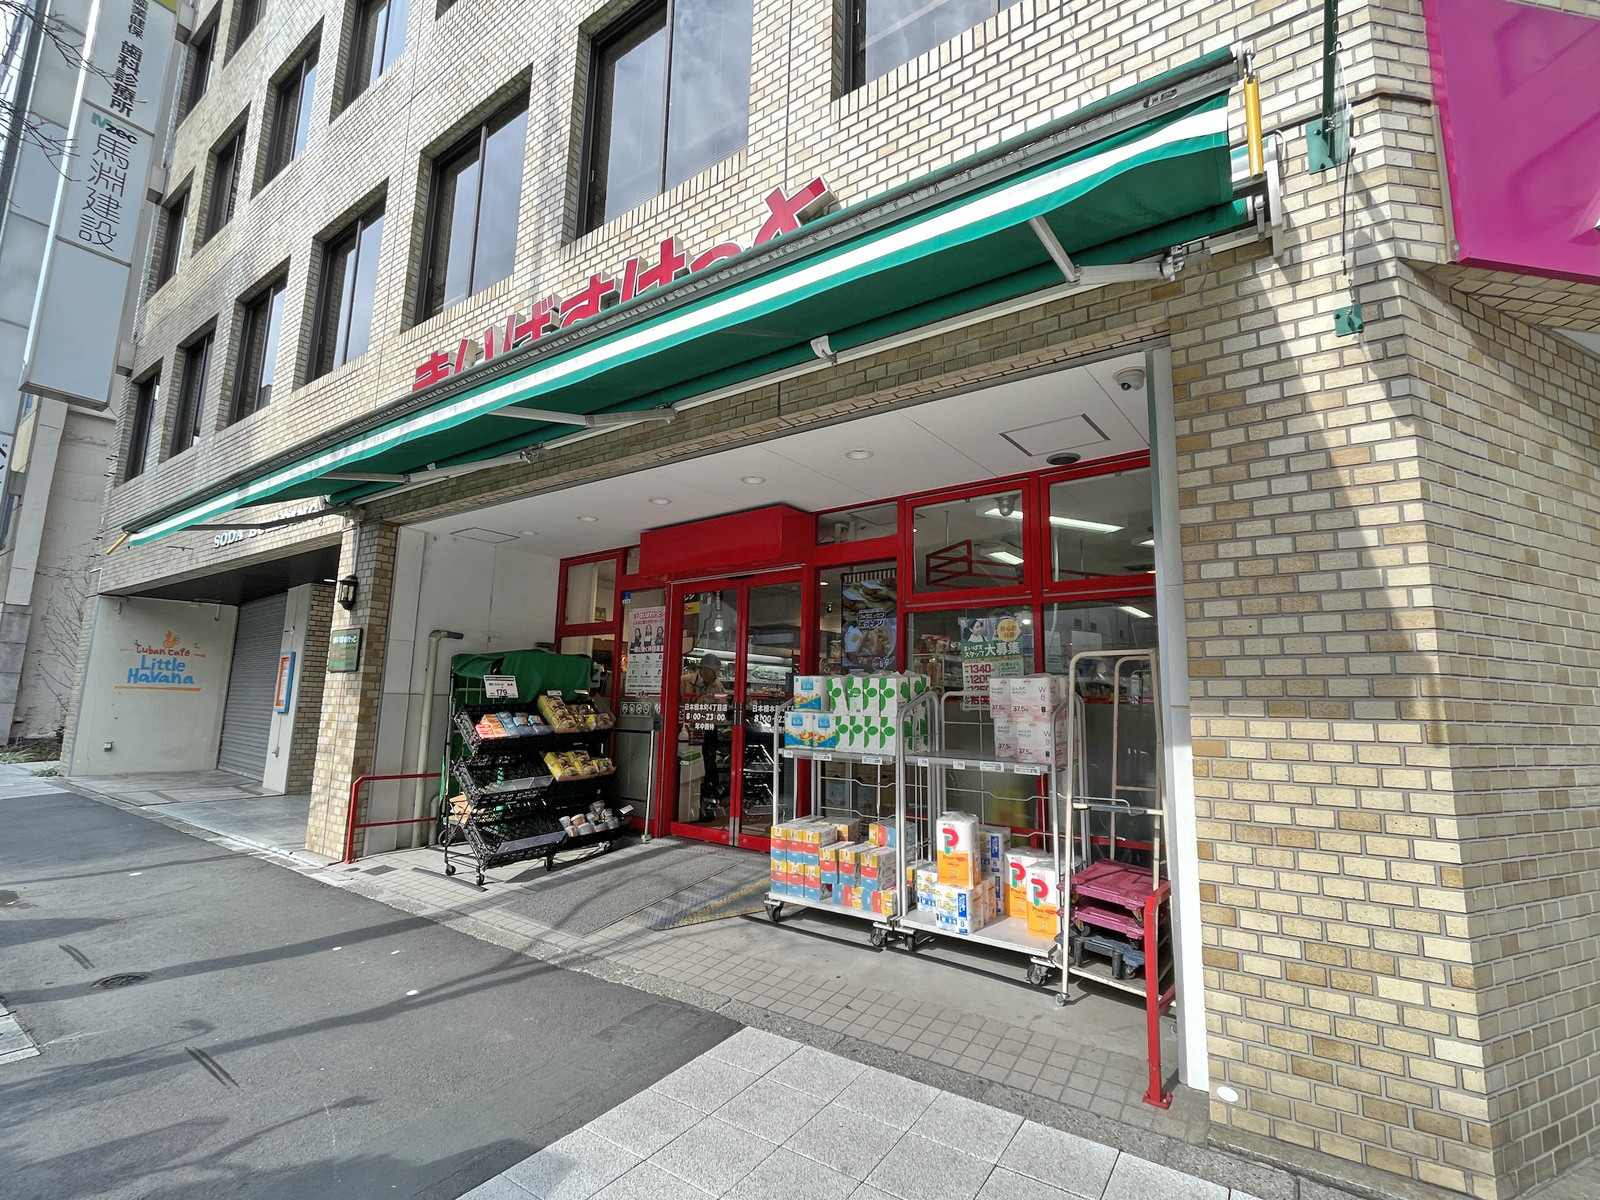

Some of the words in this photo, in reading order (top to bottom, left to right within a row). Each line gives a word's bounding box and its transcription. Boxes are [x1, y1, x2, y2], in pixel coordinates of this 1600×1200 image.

[79, 133, 131, 252] 馬淵建設
[213, 529, 244, 548] SODA
[140, 654, 186, 672] Little
[127, 667, 195, 684] Havana
